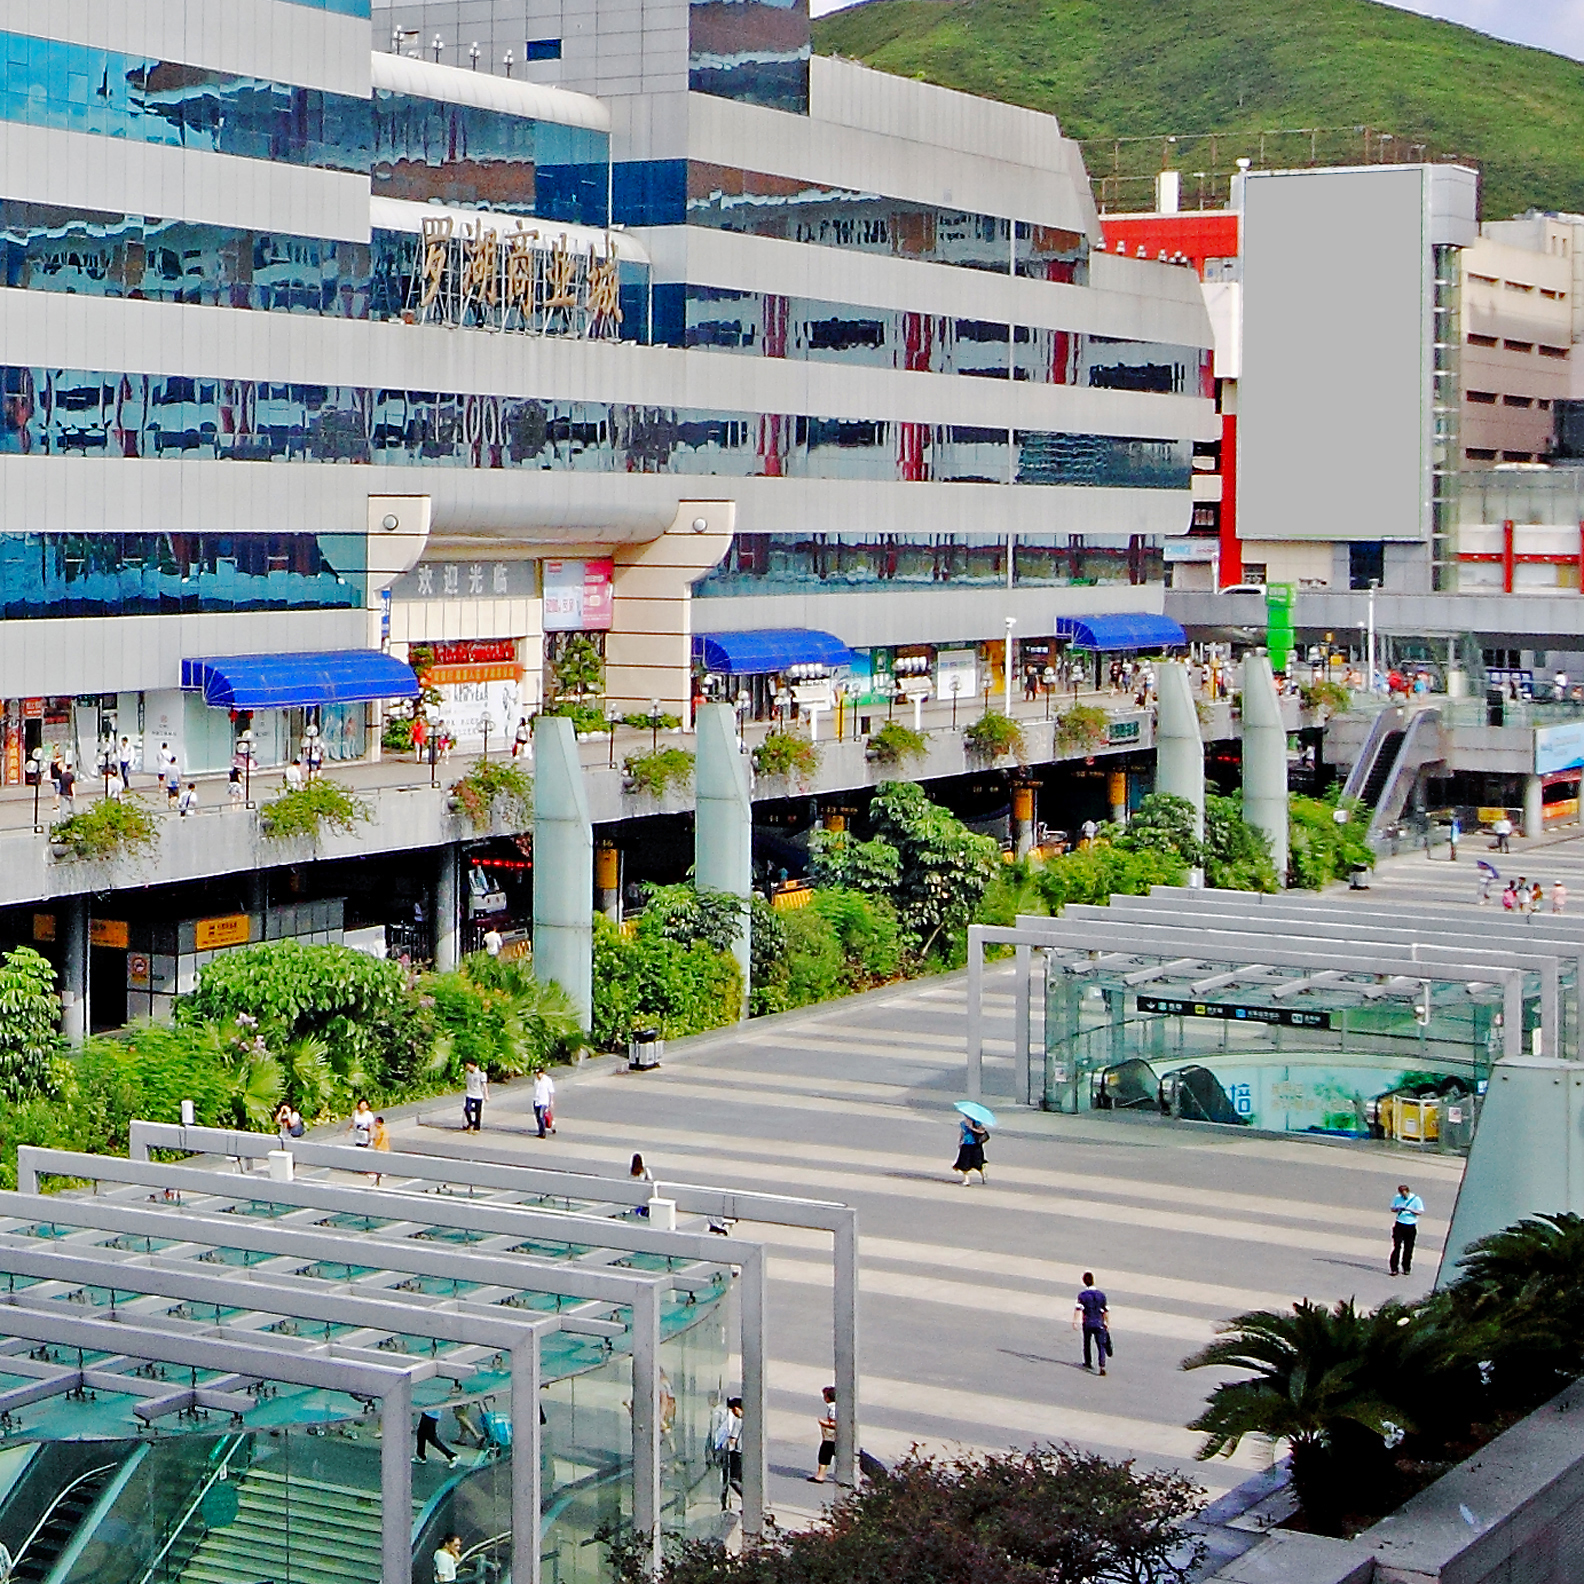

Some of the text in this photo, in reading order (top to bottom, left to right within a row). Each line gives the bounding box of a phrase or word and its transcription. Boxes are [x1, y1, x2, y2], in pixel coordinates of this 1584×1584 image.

[421, 216, 623, 323] 罗湖商业城
[417, 563, 508, 595] 欢迎光临
